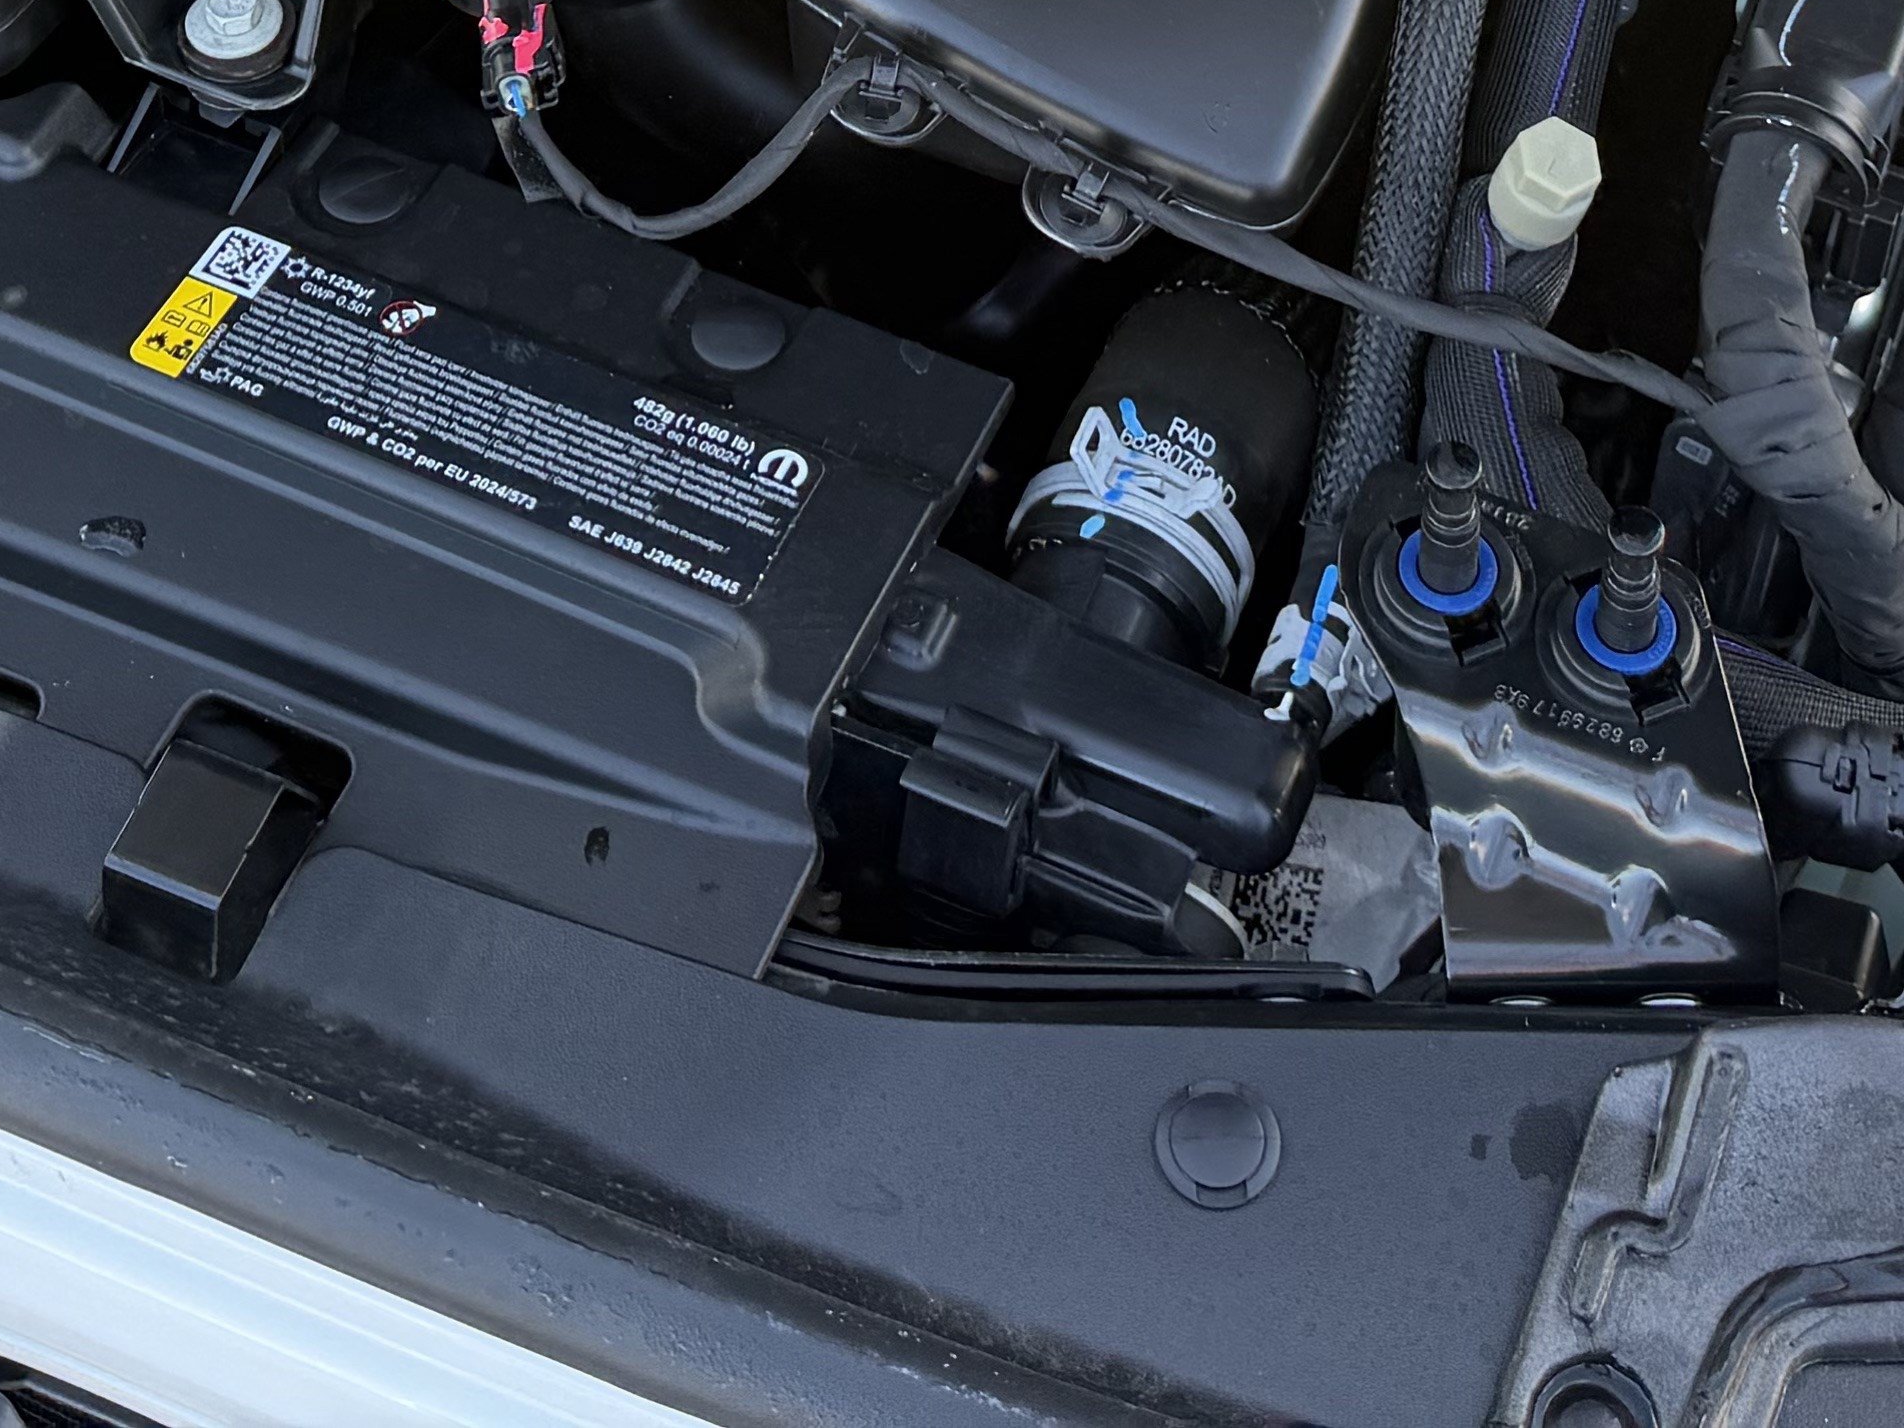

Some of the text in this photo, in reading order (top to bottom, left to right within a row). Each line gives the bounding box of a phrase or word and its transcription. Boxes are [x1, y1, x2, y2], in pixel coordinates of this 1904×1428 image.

[299, 281, 373, 317] GWP 0.501
[310, 266, 375, 300] R-1234yf
[229, 375, 265, 397] PAG
[633, 396, 756, 457] 482g (1.060 lb)
[633, 414, 667, 436] CO2
[666, 429, 685, 447] eq
[686, 436, 742, 466] 0.00024
[1167, 416, 1216, 459] RAD
[326, 415, 366, 438] GWP
[365, 431, 380, 446] &
[381, 437, 416, 461] CO2
[443, 463, 470, 483] EU
[468, 473, 539, 512] 2024/573
[1120, 427, 1236, 509] 6828078D
[568, 514, 742, 595] SAE J639 J2842 J2845
